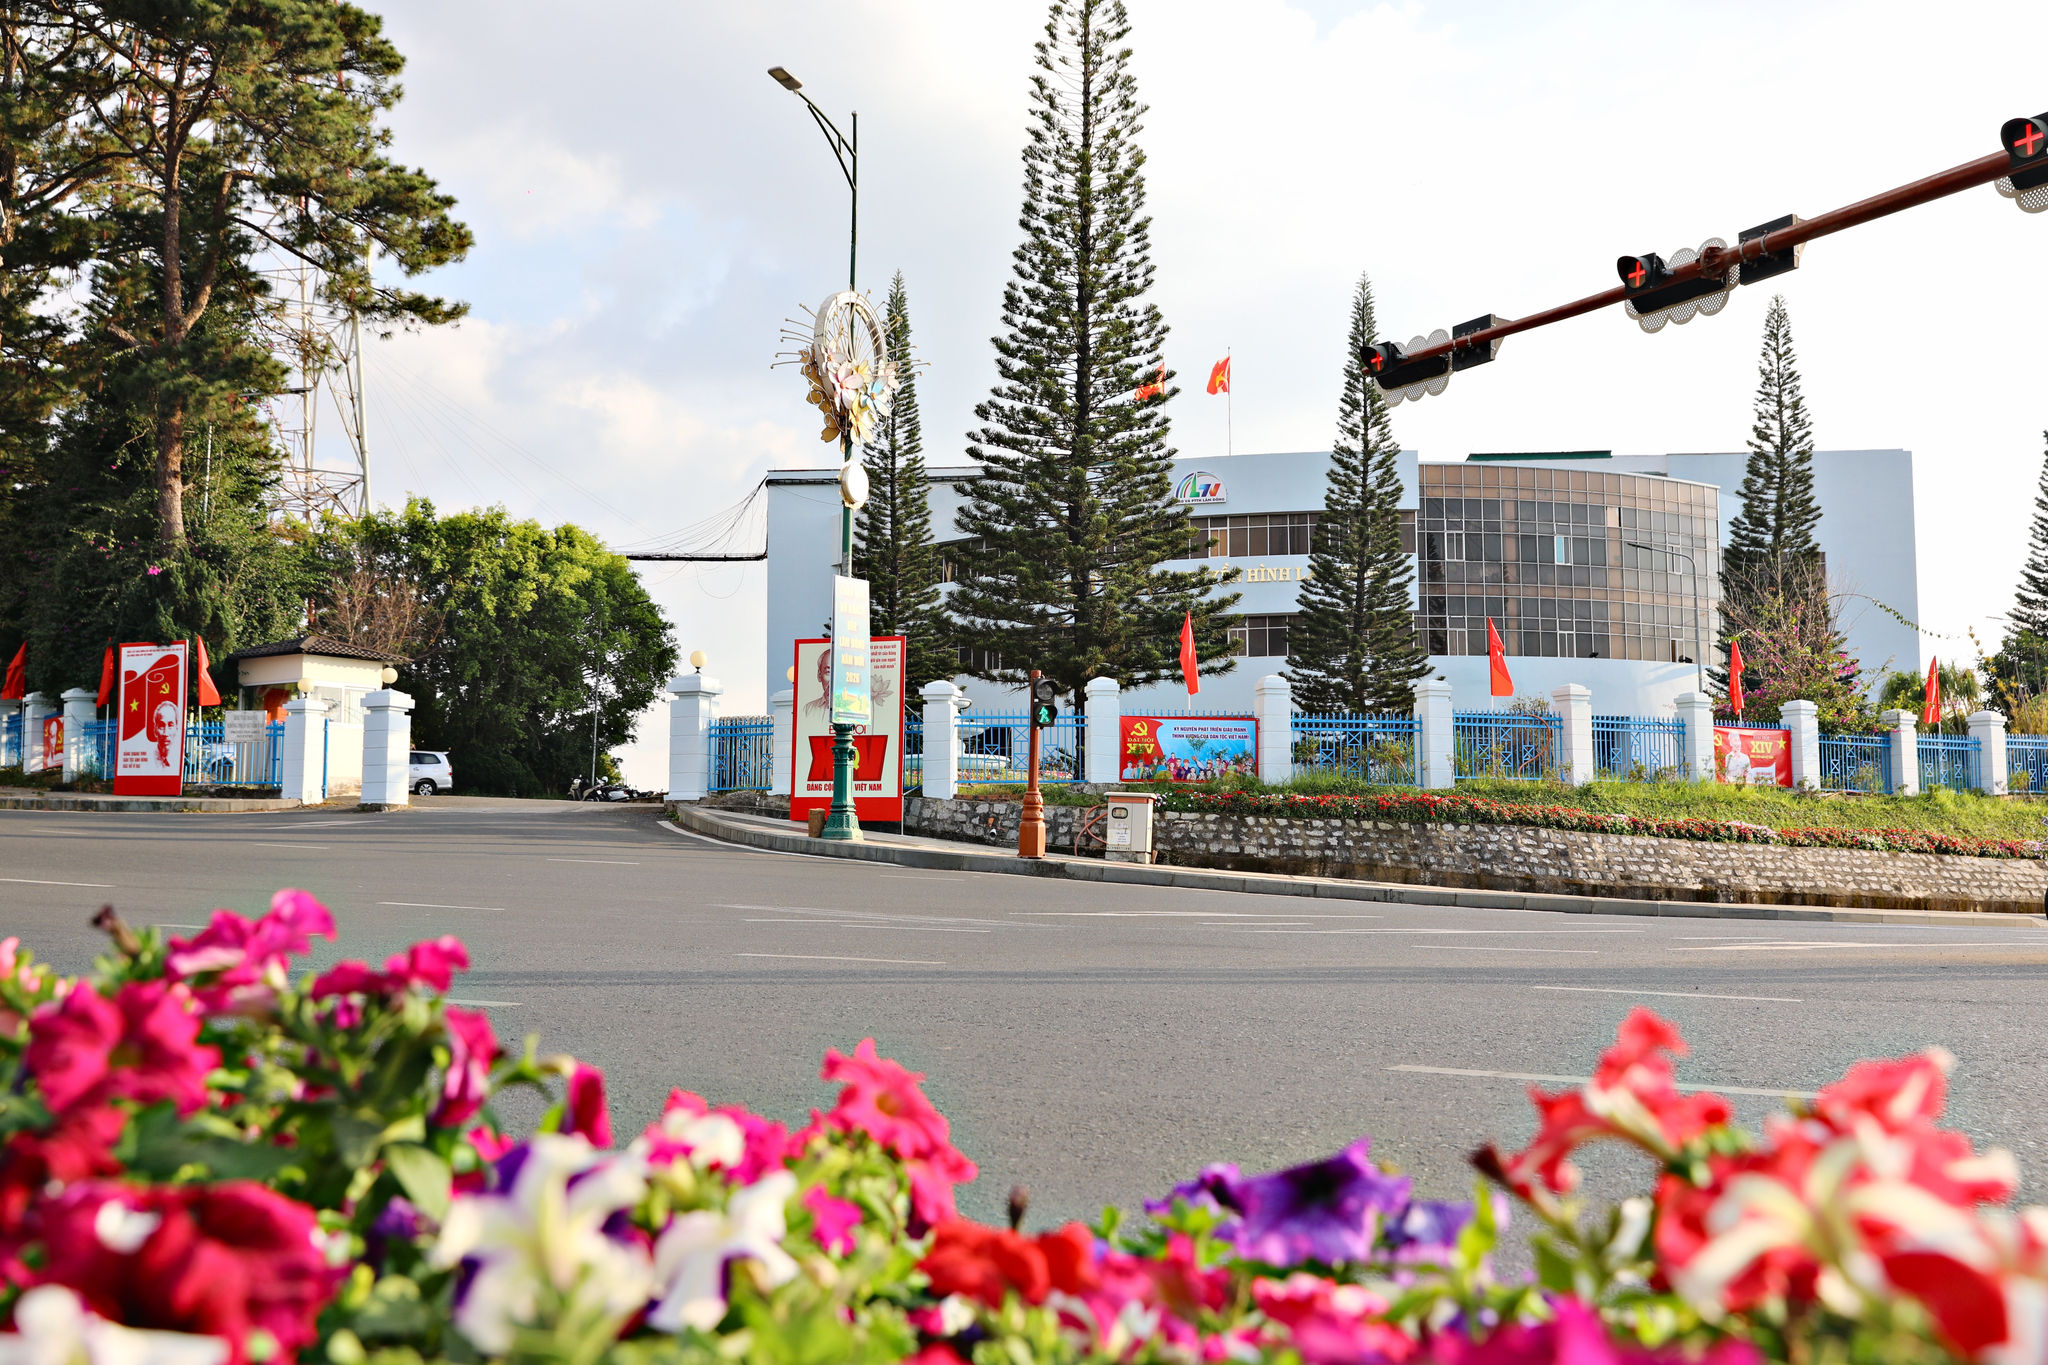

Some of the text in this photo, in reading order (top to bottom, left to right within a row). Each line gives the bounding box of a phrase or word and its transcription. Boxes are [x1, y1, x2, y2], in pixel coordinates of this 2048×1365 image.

[1246, 563, 1291, 583] HÌNH
[1750, 741, 1773, 754] XIV
[806, 782, 823, 791] ĐẢNG
[854, 782, 868, 792] VIỆT
[868, 783, 882, 791] NAM
